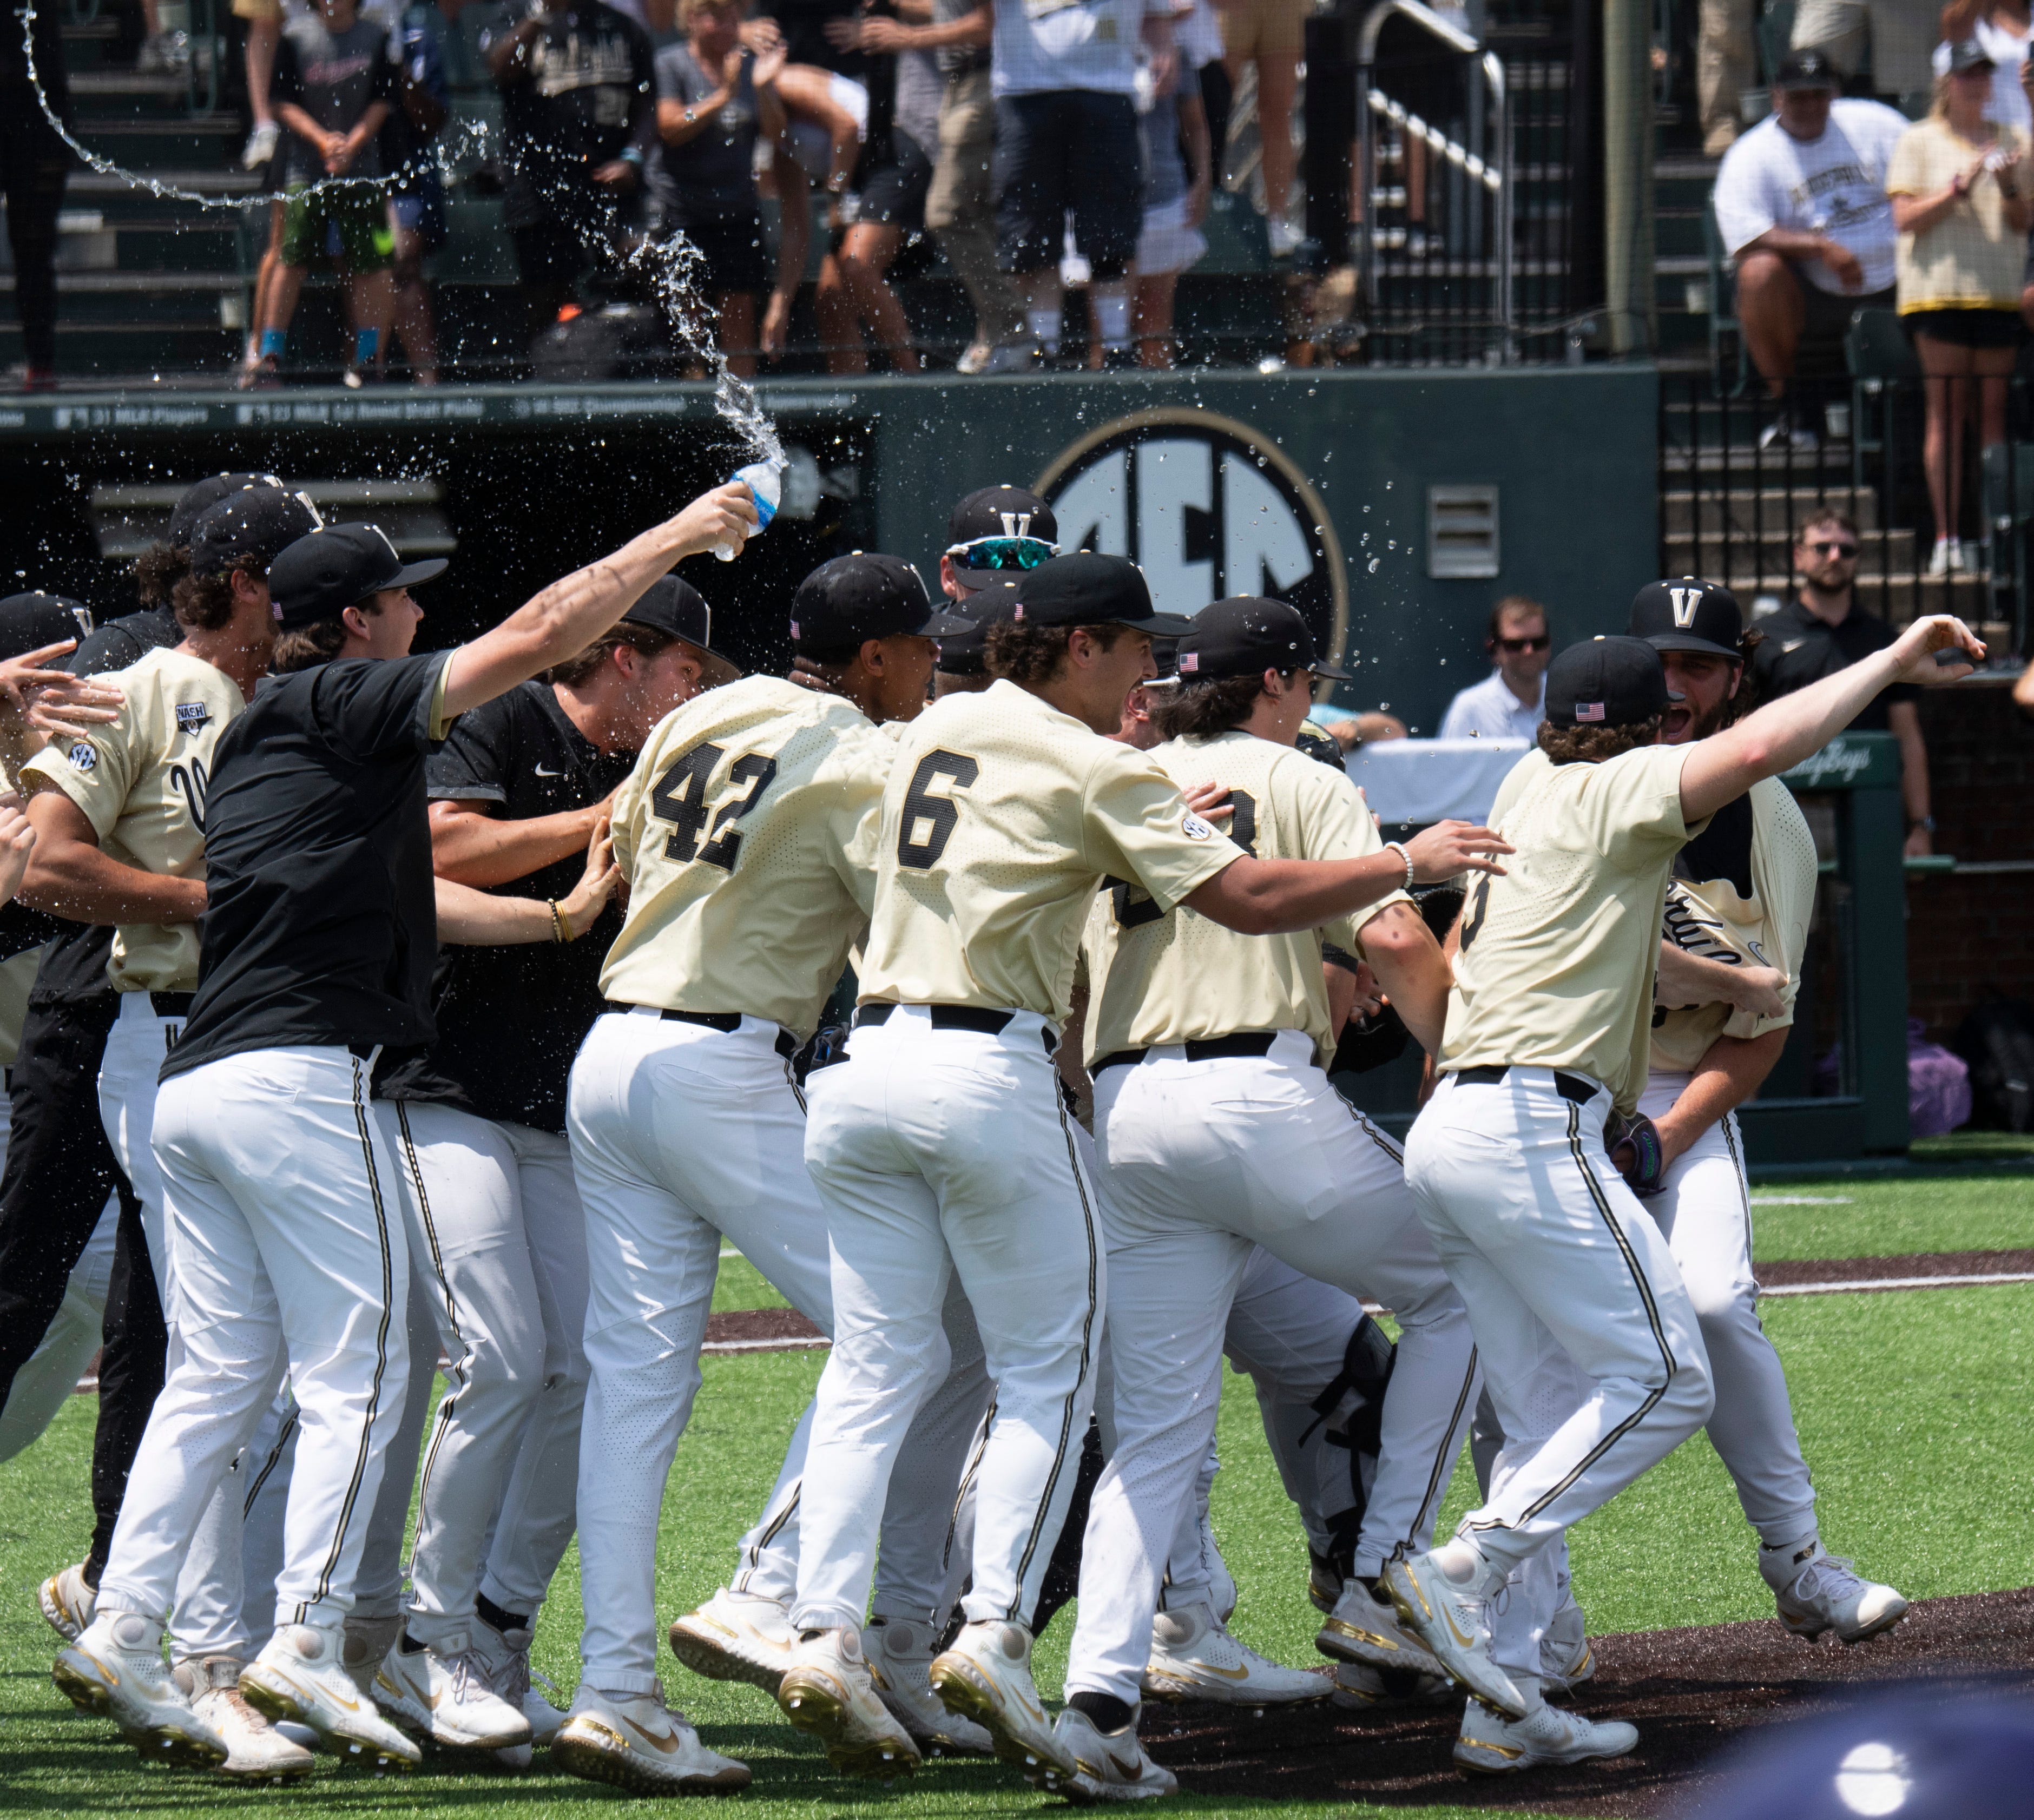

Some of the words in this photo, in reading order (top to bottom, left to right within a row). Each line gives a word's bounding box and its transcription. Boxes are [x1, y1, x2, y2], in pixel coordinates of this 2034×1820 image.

[1670, 588, 1703, 629] V
[177, 705, 204, 718] NASH
[648, 740, 780, 874] 42
[896, 744, 983, 874] 6
